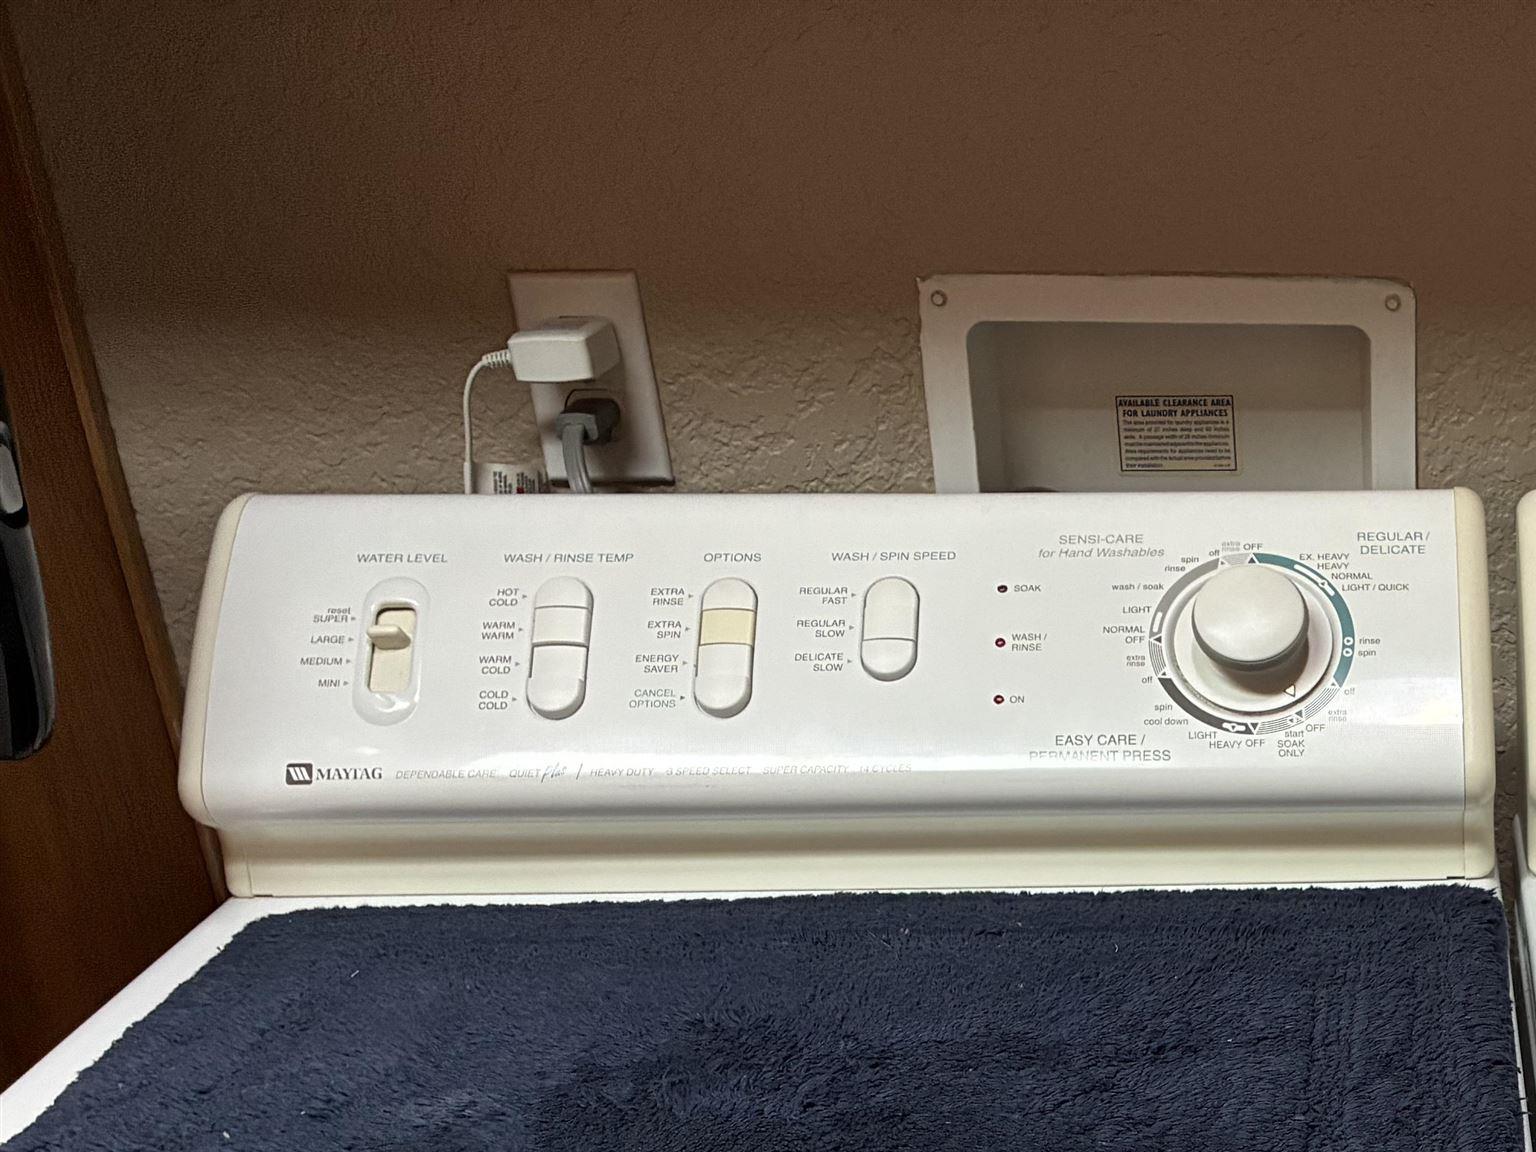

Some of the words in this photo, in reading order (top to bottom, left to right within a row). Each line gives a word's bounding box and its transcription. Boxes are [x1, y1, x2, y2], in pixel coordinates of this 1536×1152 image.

[1059, 534, 1143, 544] SENSI-CARE
[1357, 532, 1423, 541] REGULAR
[1038, 549, 1056, 559] for
[1059, 549, 1094, 558] Hand
[1097, 548, 1164, 557] Washables
[1360, 545, 1426, 554] DELICATE
[357, 553, 404, 563] WATER
[407, 553, 447, 563] LEVEL
[504, 553, 541, 563] WASH
[554, 553, 593, 563] RINSE
[598, 553, 633, 563] TEMP
[704, 553, 761, 562] OPTIONS
[832, 552, 869, 561] WASH
[880, 552, 910, 561] SPIN
[913, 551, 956, 561] SPEED
[1181, 556, 1199, 564] spin
[651, 588, 685, 596] EXTRA
[799, 587, 848, 595] REGULAR
[1014, 584, 1041, 592] SOAK
[497, 588, 519, 597] HOT
[489, 599, 518, 607] COLD
[653, 598, 684, 606] RINSE
[822, 596, 848, 605] FAST
[1123, 606, 1151, 614] LIGHT
[483, 622, 515, 630] WARM
[648, 621, 681, 629] EXTRA
[797, 620, 845, 628] REGULAR
[482, 632, 515, 640] WARM
[657, 631, 681, 639] SPIN
[815, 629, 845, 637] SLOW
[1012, 633, 1039, 641] WASH
[311, 636, 345, 644] LARGE
[1125, 636, 1144, 644] OFF
[1012, 643, 1042, 652] RINSE
[300, 657, 342, 665] MEDIUM
[479, 656, 512, 664] WARM
[635, 655, 679, 663] ENERGY
[795, 653, 843, 661] DELICATE
[482, 666, 511, 675] COLD
[644, 665, 678, 673] SAVER
[813, 663, 843, 671] SLOW
[318, 679, 340, 687] MINI
[479, 691, 508, 699] COLD
[634, 690, 675, 698] CANCEL
[1009, 695, 1025, 704] ON
[479, 702, 507, 710] COLD
[629, 700, 676, 708] OPTIONS
[1155, 703, 1173, 711] spin
[1306, 724, 1325, 732] OFF
[1055, 735, 1093, 745] EASY
[1097, 735, 1136, 745] CARE
[1123, 750, 1171, 761] PRESS
[316, 767, 382, 780] MAYTAG
[396, 769, 464, 779] DEPENDABLE
[468, 769, 496, 779] CARE
[510, 769, 541, 778] QUIET
[590, 769, 624, 777] HEAVY
[627, 768, 655, 777] DUTY
[675, 767, 710, 775] SPEED
[712, 766, 751, 775] SELECT
